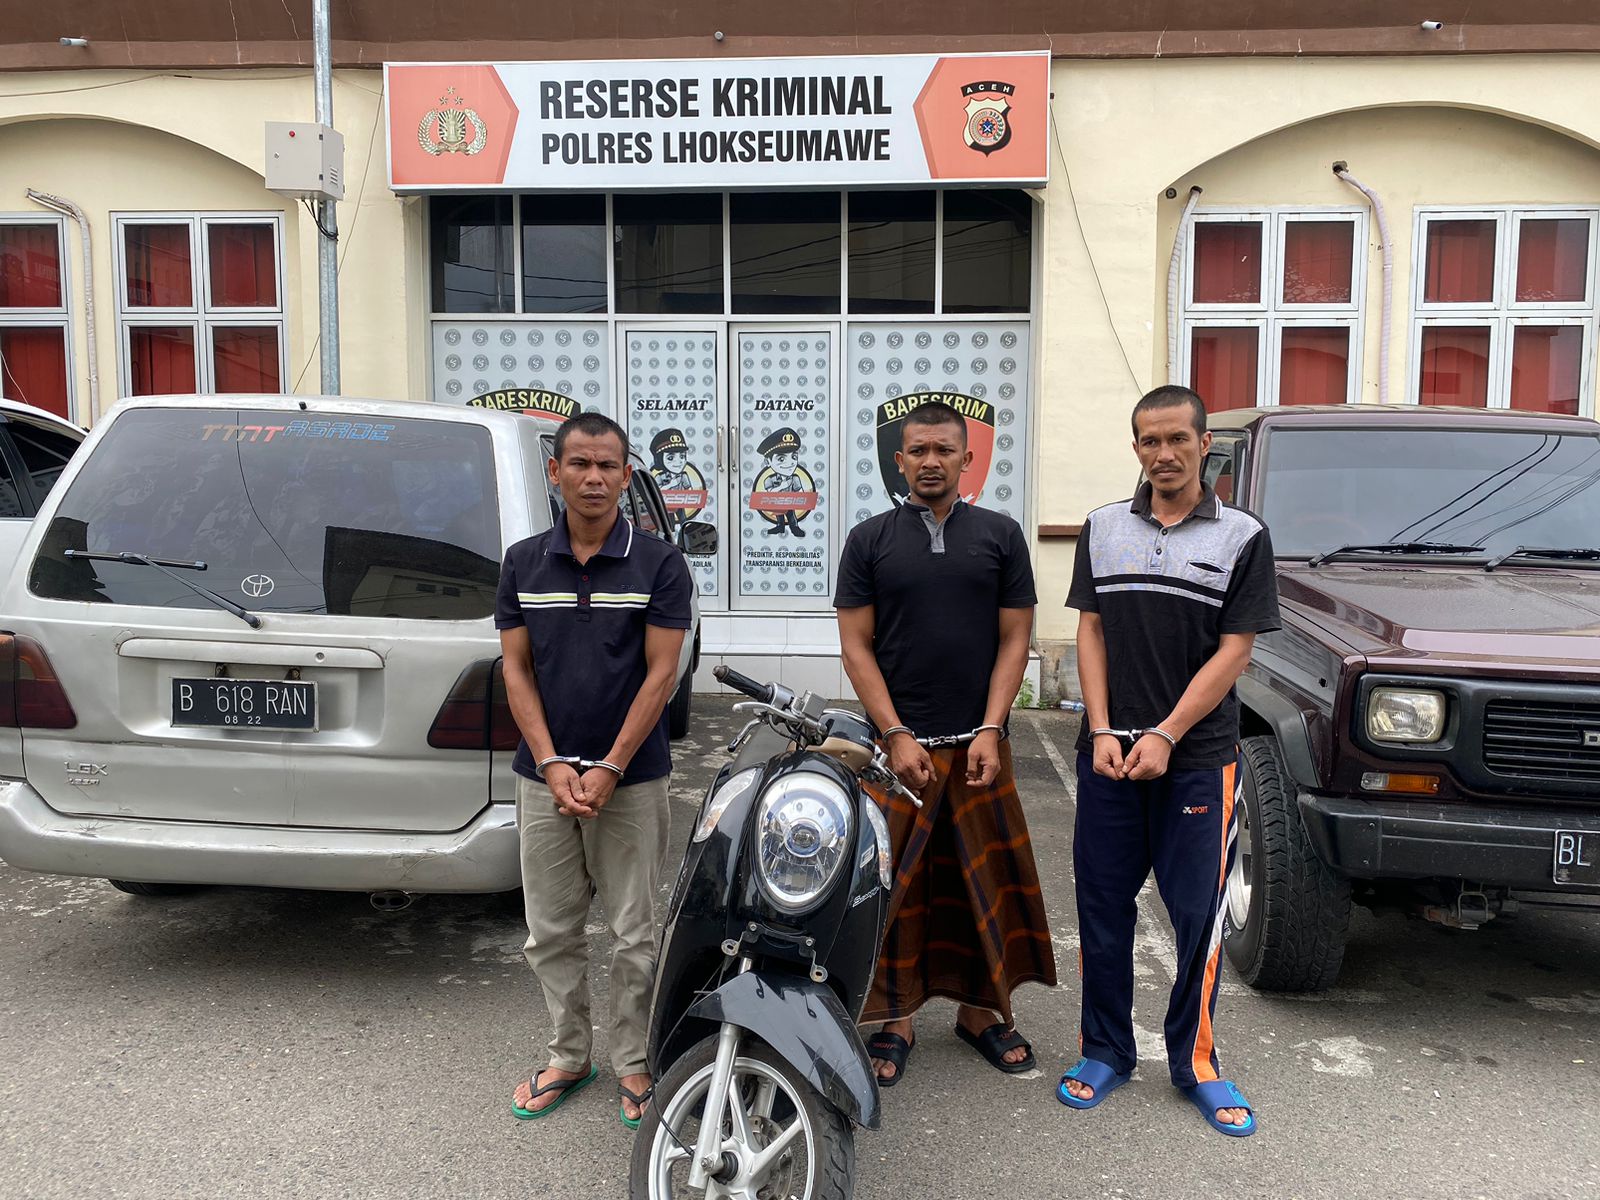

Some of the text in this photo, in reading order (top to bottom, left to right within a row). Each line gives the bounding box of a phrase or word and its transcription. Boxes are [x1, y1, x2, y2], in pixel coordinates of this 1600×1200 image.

[540, 76, 892, 119] RESERSE KRIMINAL
[966, 84, 1010, 93] ACEH
[542, 129, 890, 165] POLRES LHOKSEUMAWE
[637, 400, 814, 411] SELAMAT DATANG
[664, 494, 702, 504] ESISI
[180, 684, 307, 715] B 618 RAN
[225, 715, 261, 725] 08 22
[1558, 834, 1591, 867] BL
